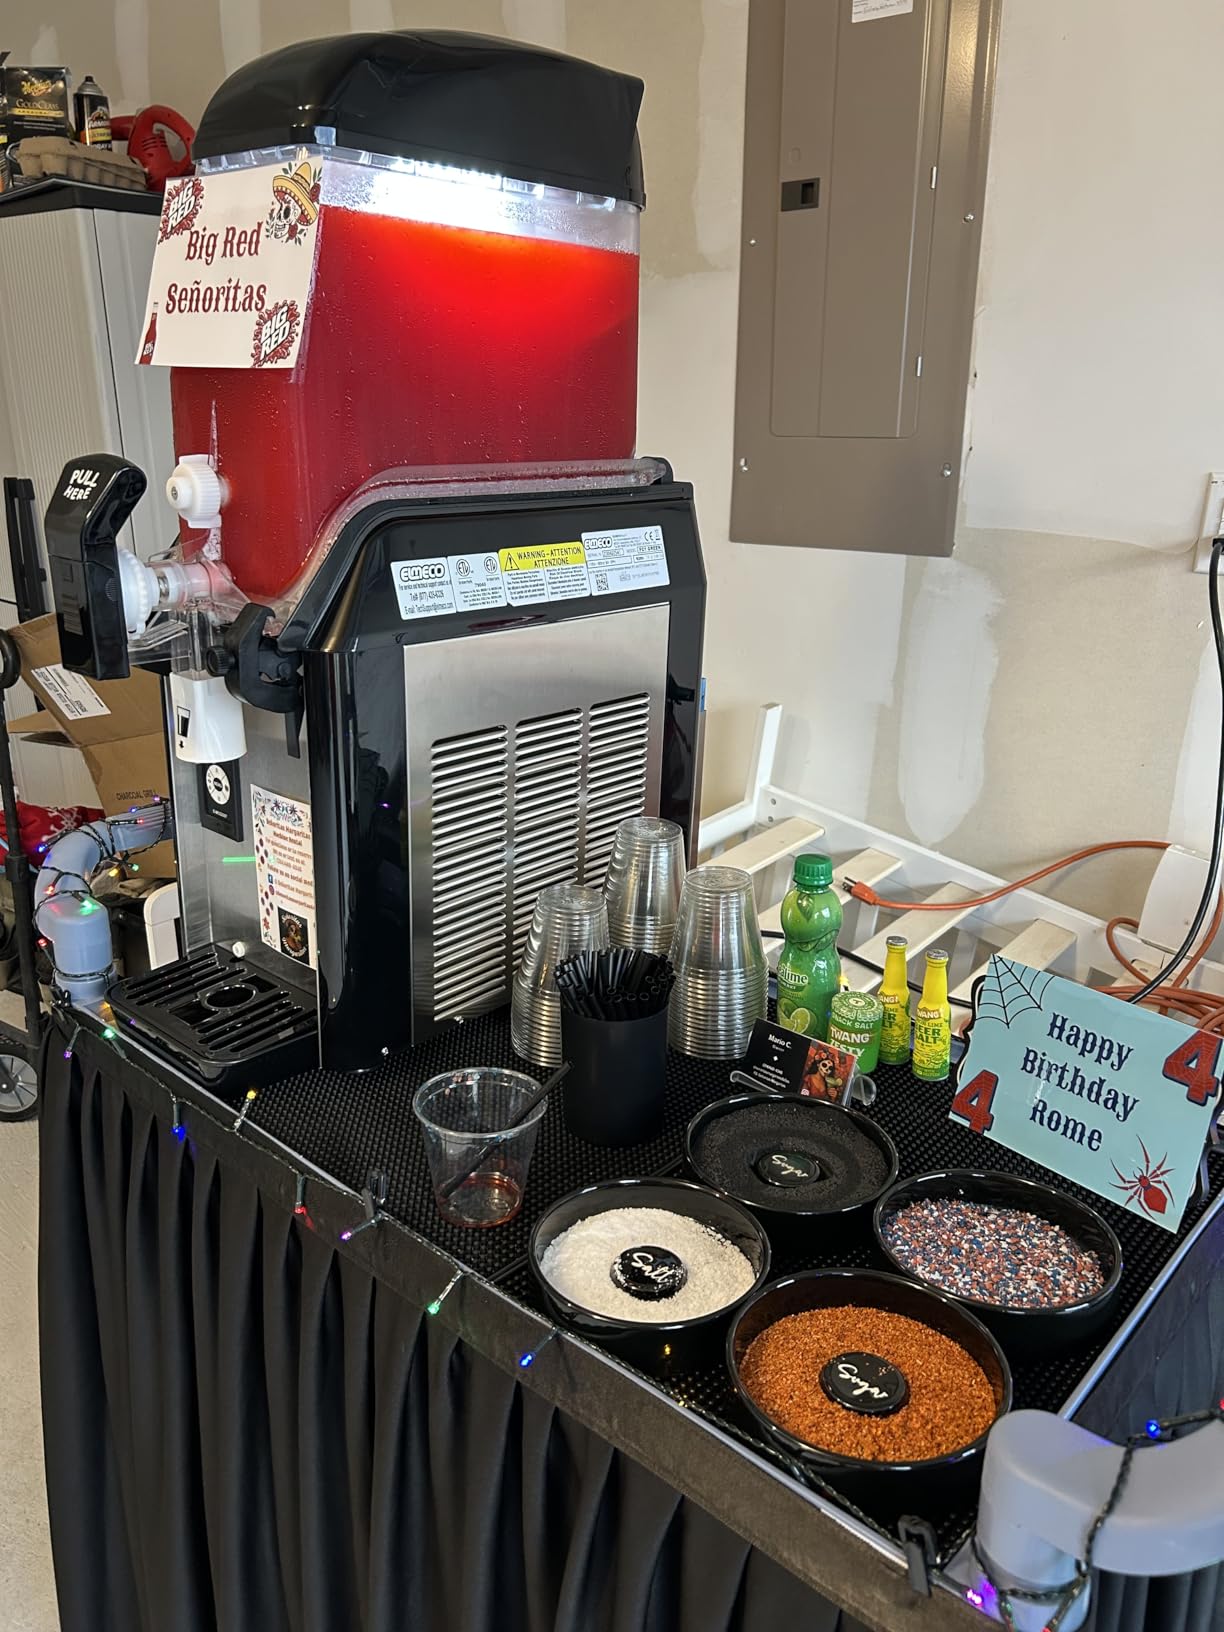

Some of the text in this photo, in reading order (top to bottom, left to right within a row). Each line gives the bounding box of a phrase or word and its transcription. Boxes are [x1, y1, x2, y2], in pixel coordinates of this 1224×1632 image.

[169, 181, 194, 215] BIG
[168, 196, 196, 233] RED
[185, 221, 264, 266] Big Red
[165, 278, 267, 314] Señoritas
[259, 321, 290, 359] RED
[261, 306, 288, 343] BIG
[63, 485, 92, 500] HERE
[69, 469, 100, 487] PULL
[517, 550, 546, 560] WARNING
[550, 547, 582, 557] ATTENTION
[584, 537, 612, 550] ELMECO
[400, 563, 445, 582] ELMECO
[534, 557, 569, 568] ATTENZIONE
[854, 1022, 874, 1030] SALT
[882, 1011, 896, 1021] ER
[882, 1020, 895, 1028] LT
[768, 1034, 785, 1046] Mario
[831, 1026, 870, 1044] TWANG
[1046, 1012, 1135, 1071] Happy
[1162, 1029, 1223, 1107] 4
[1021, 1047, 1140, 1122] Birthday
[951, 1069, 999, 1135] 4
[1029, 1098, 1103, 1152] Rome
[772, 1154, 808, 1177] Sugar
[631, 1252, 674, 1283] Salt
[838, 1363, 889, 1399] Sugar
